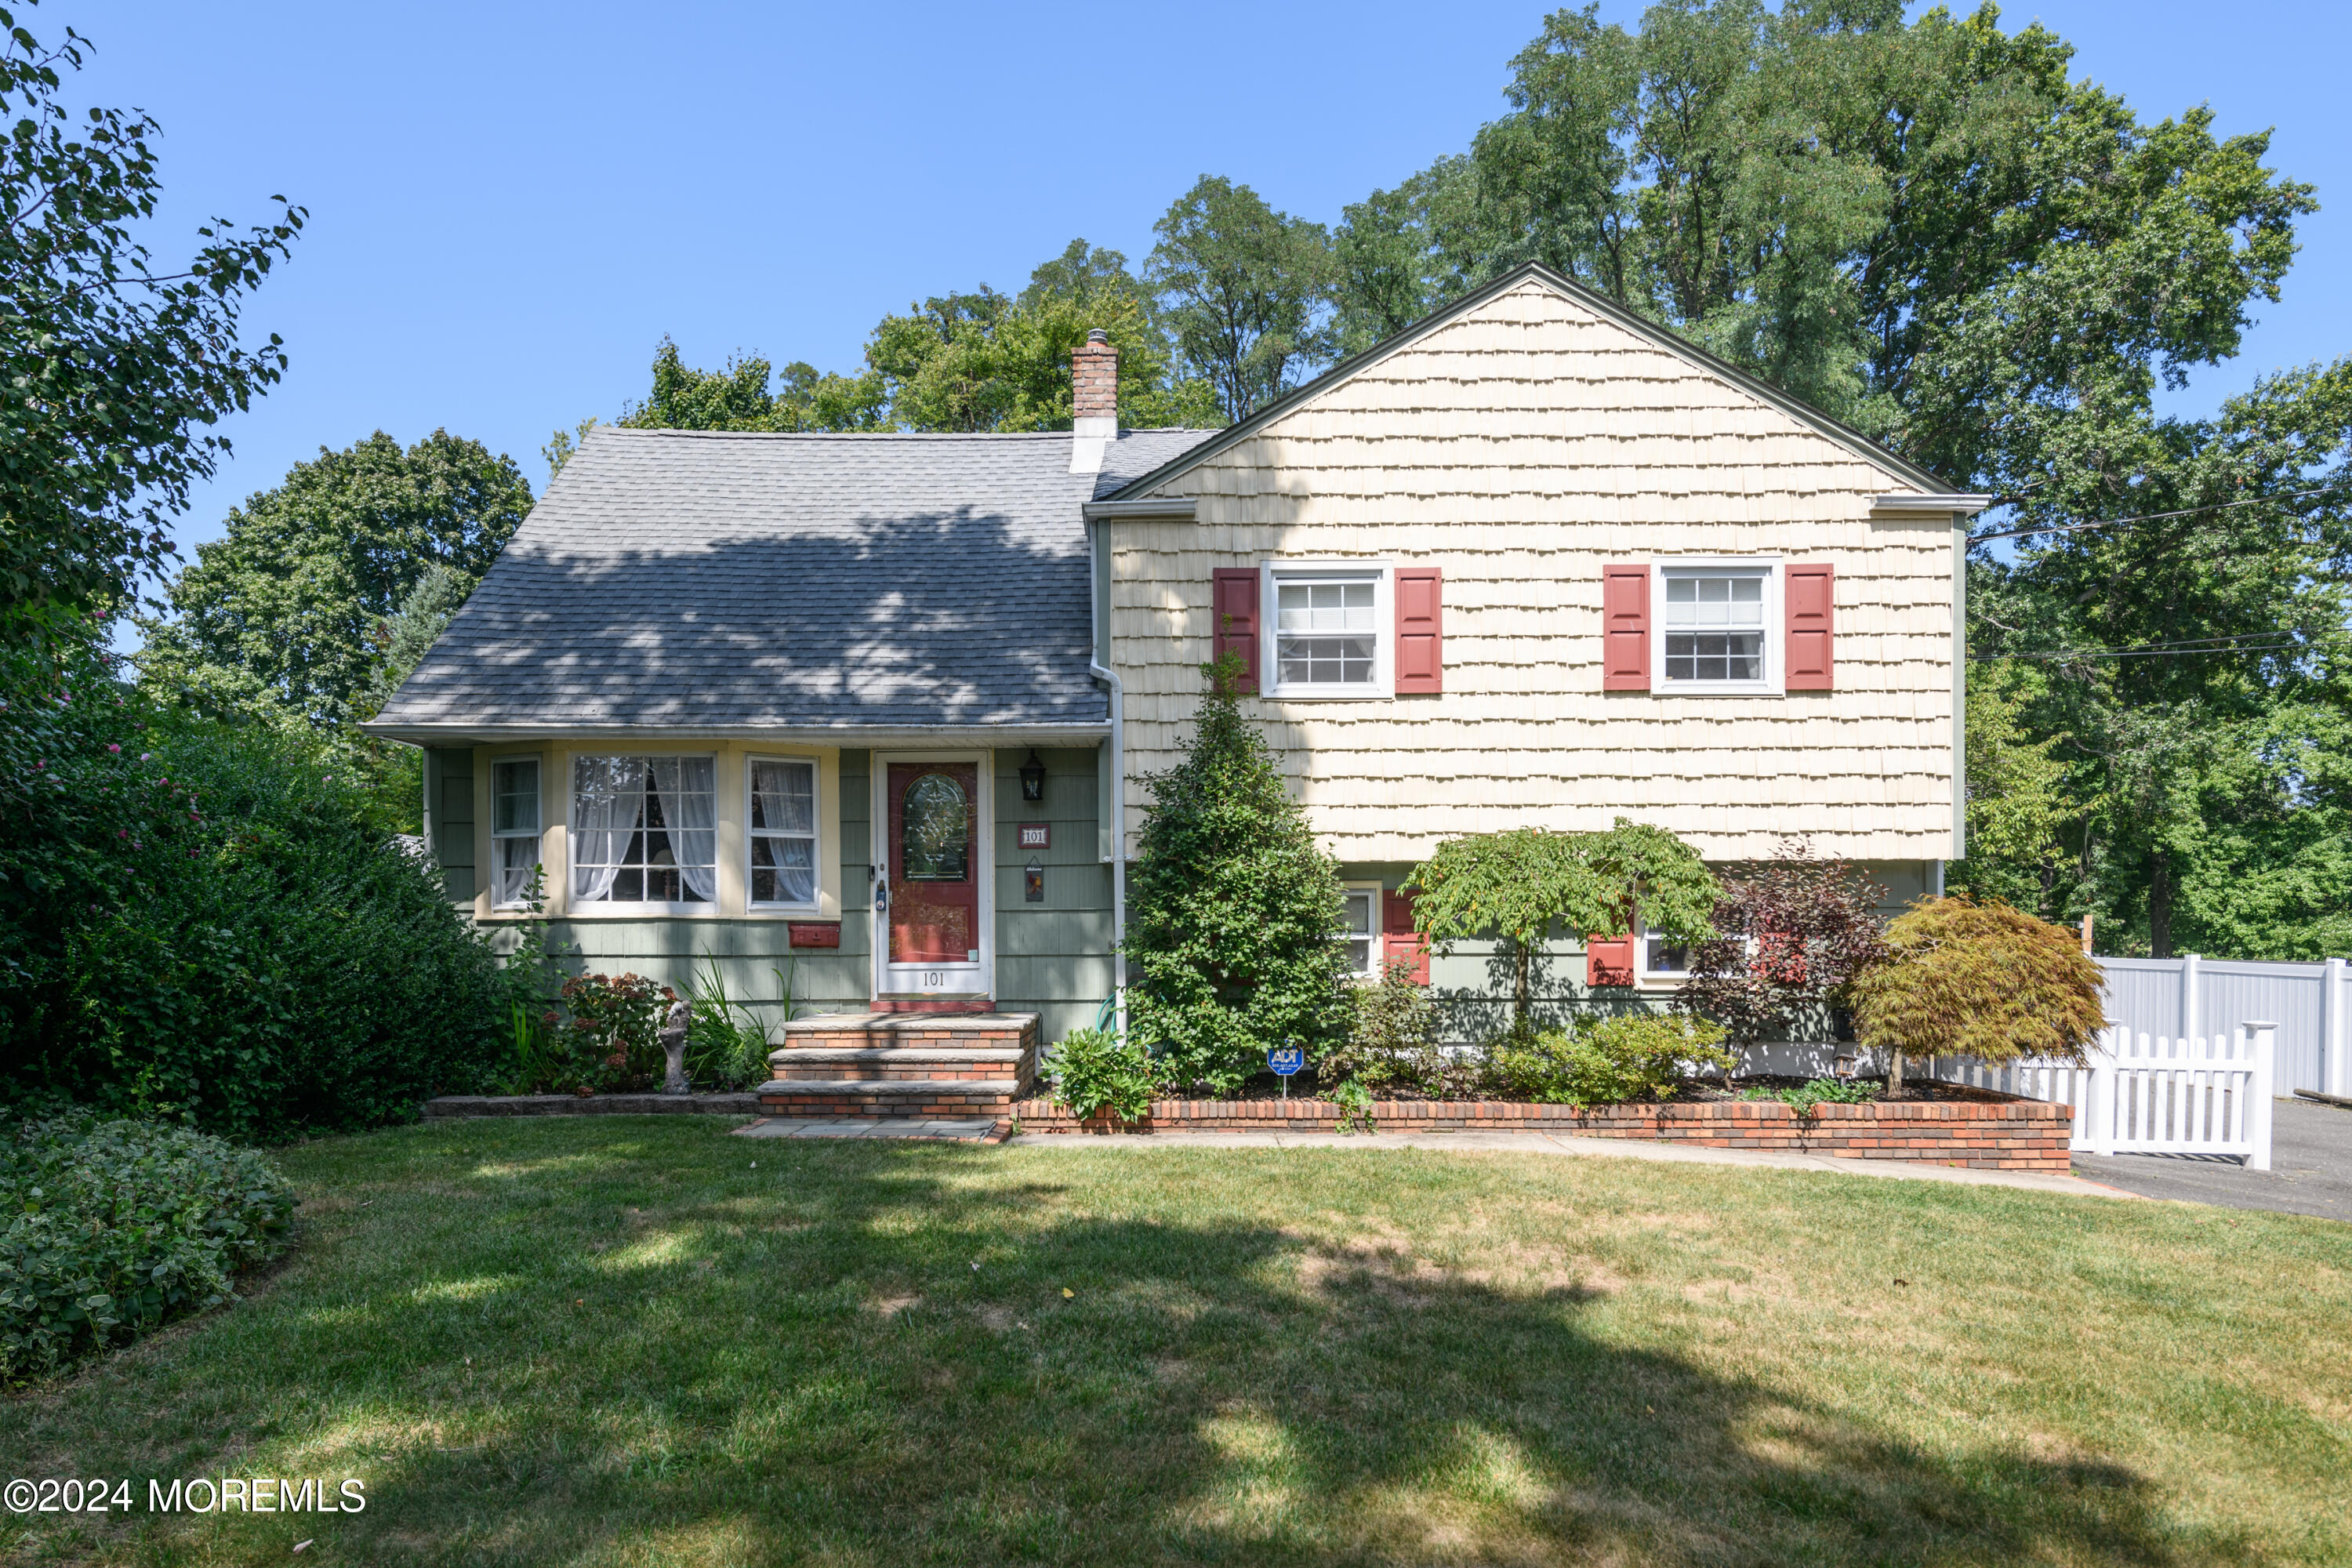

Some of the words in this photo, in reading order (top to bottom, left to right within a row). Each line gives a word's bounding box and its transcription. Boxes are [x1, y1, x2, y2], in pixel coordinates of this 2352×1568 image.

[1026, 831, 1042, 841] 101
[924, 972, 943, 986] 101
[1271, 1049, 1298, 1063] ADT
